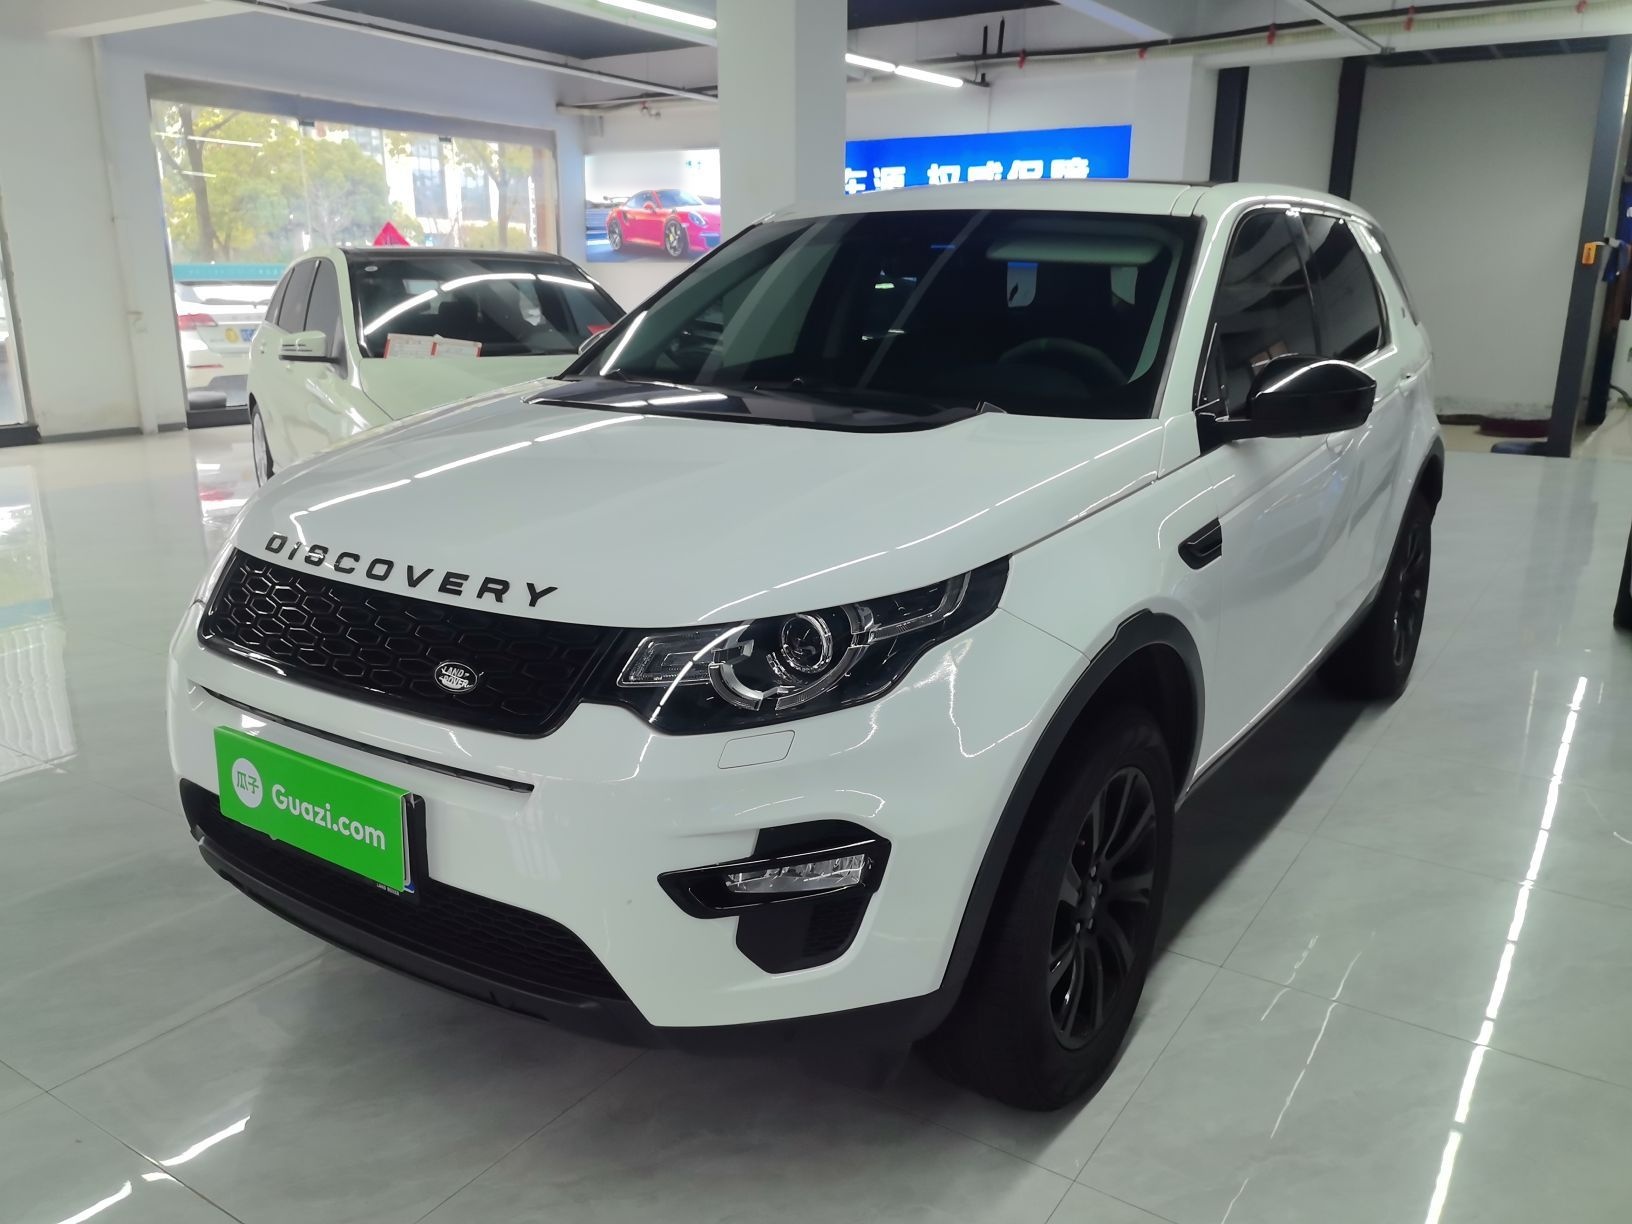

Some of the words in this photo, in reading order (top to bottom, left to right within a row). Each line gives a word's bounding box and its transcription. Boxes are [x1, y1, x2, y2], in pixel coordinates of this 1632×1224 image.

[265, 533, 558, 607] DISCOVERY
[441, 666, 464, 677] LAND
[442, 675, 469, 688] ROVER
[236, 770, 259, 794] 瓜子
[272, 784, 386, 850] Guazi.com
